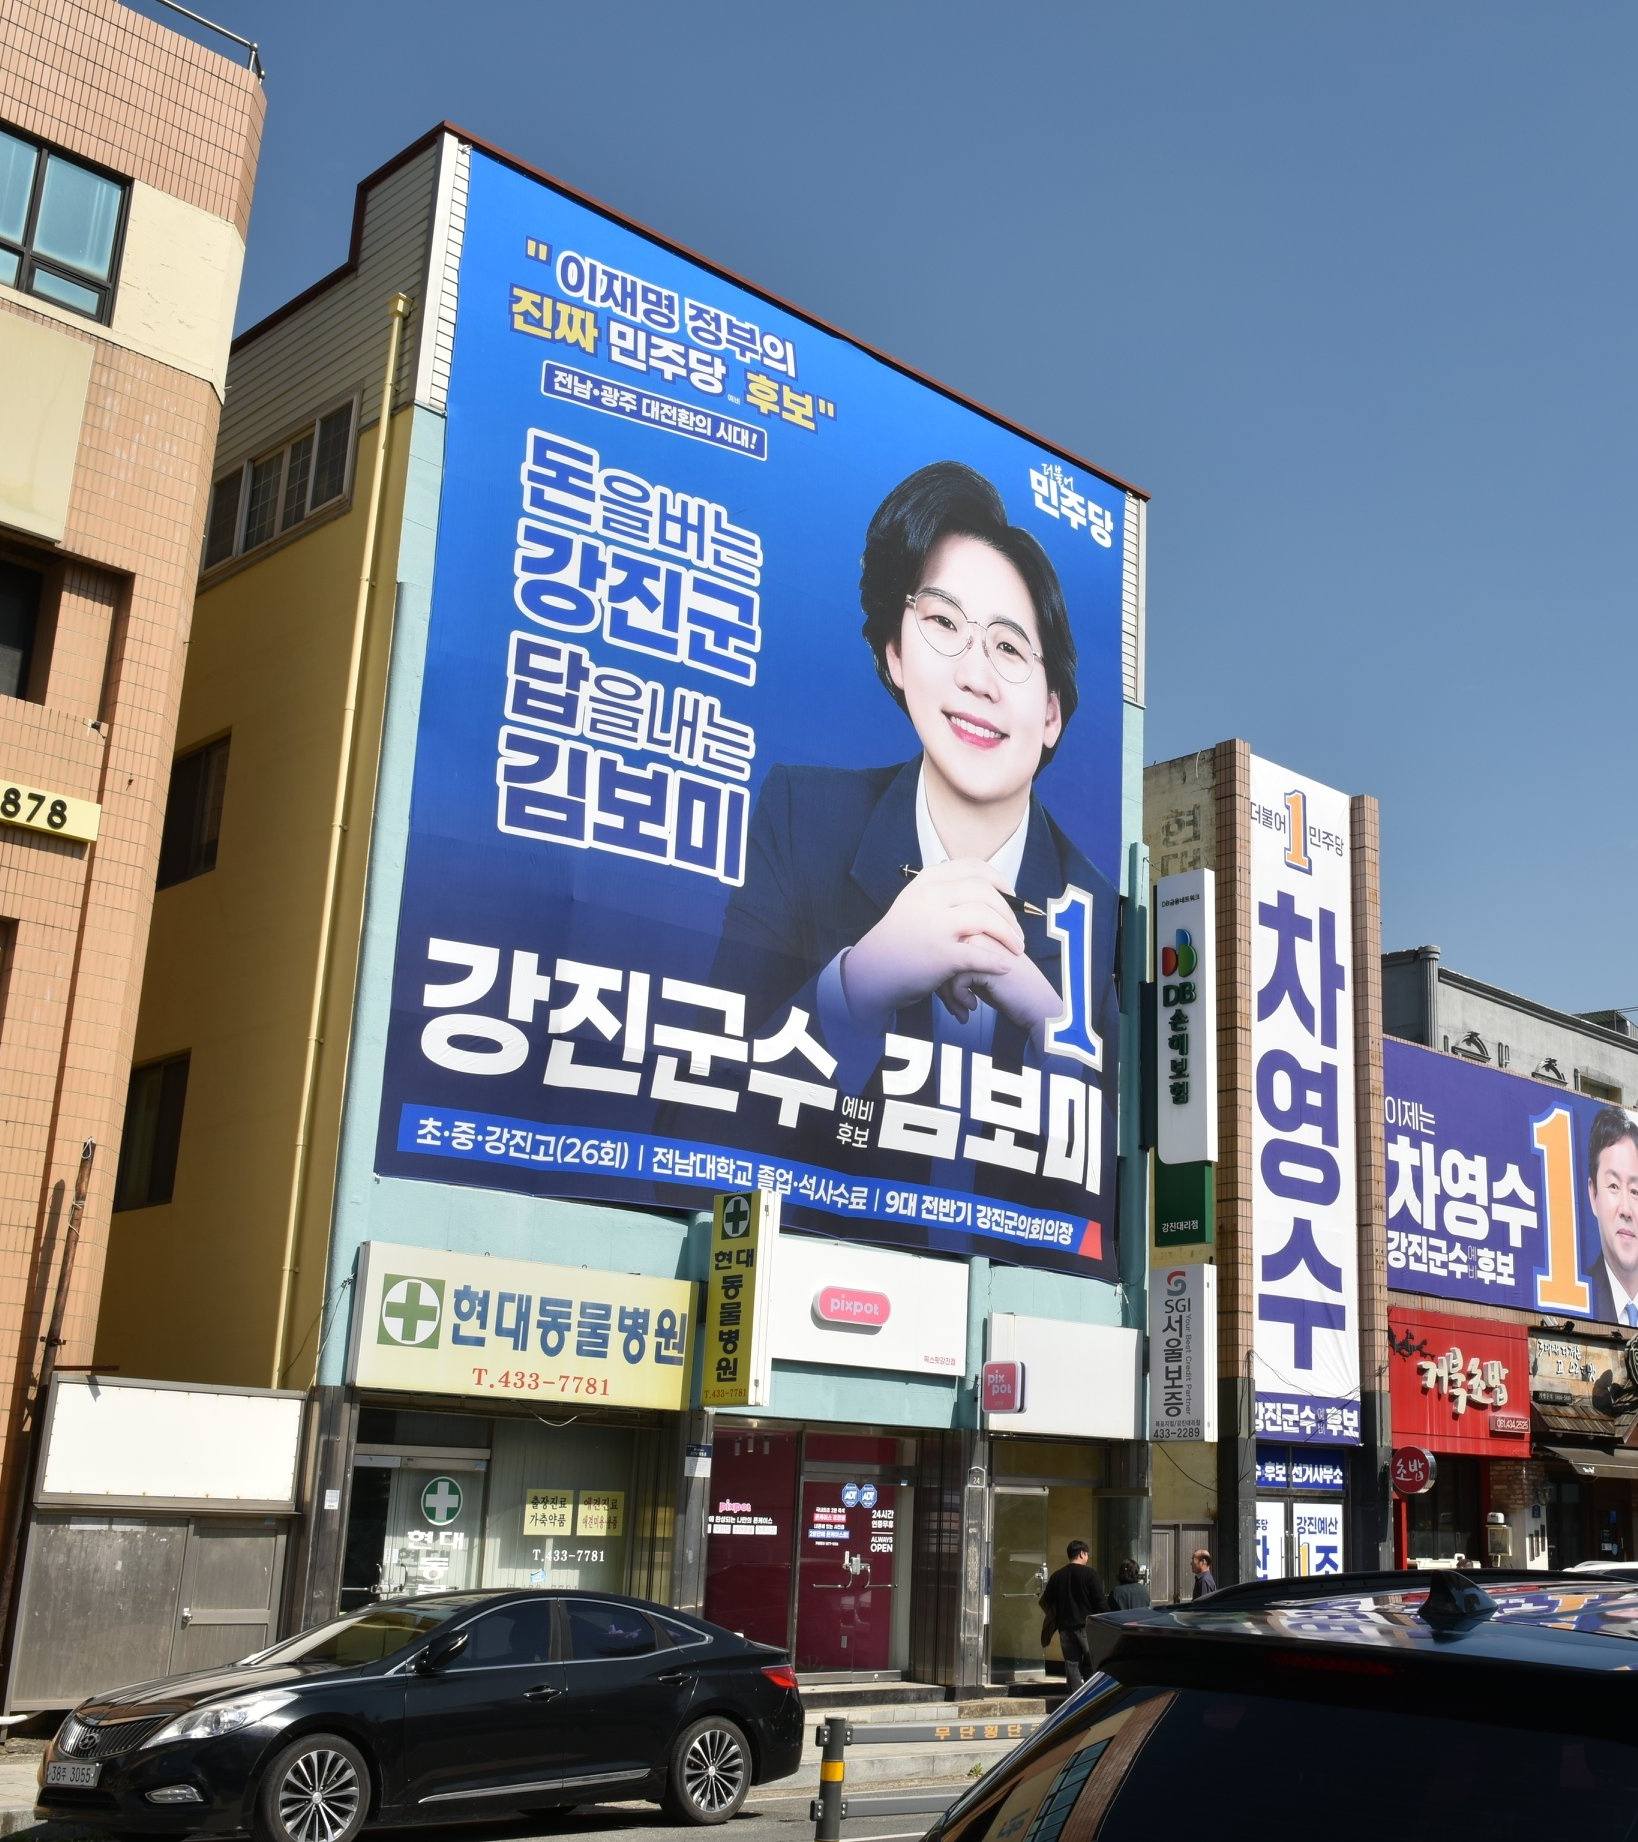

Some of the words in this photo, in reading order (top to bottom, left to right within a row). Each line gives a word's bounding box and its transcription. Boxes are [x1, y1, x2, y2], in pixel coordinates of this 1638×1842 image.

[510, 286, 597, 353] 진짜
[608, 321, 726, 395] 민주당
[684, 298, 797, 377] 정부의
[553, 371, 637, 413] 전남·광주
[642, 398, 712, 437] 대전환의
[717, 421, 758, 450] 시대!
[1029, 468, 1113, 548] 민주당
[514, 518, 761, 686] 강진군
[1, 788, 67, 830] 878
[497, 725, 750, 887] 김보미
[1250, 801, 1287, 834] 더불어
[1284, 789, 1312, 876] 1
[1309, 825, 1344, 857] 민주당
[1044, 883, 1103, 1072] 1
[1162, 981, 1197, 1007] DB
[421, 937, 838, 1128] 강진군수
[877, 1033, 1103, 1196] 김보미
[1168, 1009, 1189, 1105] 손해보험
[842, 1096, 874, 1122] 예비
[1385, 1096, 1436, 1136] 이제는
[836, 1122, 870, 1149] 후보
[1256, 889, 1345, 1370] 차영수
[652, 1148, 752, 1186] 전남대학교
[757, 1164, 867, 1211] 졸업·석사수료
[885, 1190, 917, 1216] 9대
[921, 1198, 972, 1226] 전반기
[976, 1206, 1073, 1245] 강진군의회의장
[1387, 1135, 1538, 1248] 차영수
[1532, 1107, 1591, 1314] 1
[1161, 1220, 1199, 1233] 강진대리점
[714, 1248, 755, 1270] 현대
[1387, 1230, 1469, 1279] 강진군수
[1477, 1247, 1515, 1286] 후보
[830, 1294, 880, 1316] pixpot
[1164, 1298, 1191, 1314] SGI
[452, 1284, 687, 1366] 현대동물병원
[716, 1274, 743, 1383] 동물병원
[988, 1369, 1005, 1386] pix
[1162, 1314, 1184, 1418] 서울보증
[1185, 1357, 1193, 1382] Credit
[472, 1367, 610, 1397] T.433-7781
[992, 1384, 1011, 1396] pot
[1185, 1384, 1193, 1415] Partner
[1154, 1427, 1200, 1438] 433-2289
[1326, 1406, 1360, 1438] 후보
[1264, 1460, 1287, 1482] 후보
[1292, 1463, 1343, 1485] 선거사무소
[1395, 1458, 1424, 1481] 초밥
[531, 1496, 567, 1510] 출장진료
[584, 1496, 618, 1510] 애견진료
[719, 1499, 752, 1513] pixpot
[872, 1510, 894, 1519] 24시간
[530, 1513, 566, 1527] 가축약품
[1297, 1517, 1339, 1535] 강진예산
[408, 1530, 464, 1550] 현대
[870, 1544, 893, 1552] OPEN
[532, 1549, 605, 1562] T.433-7781
